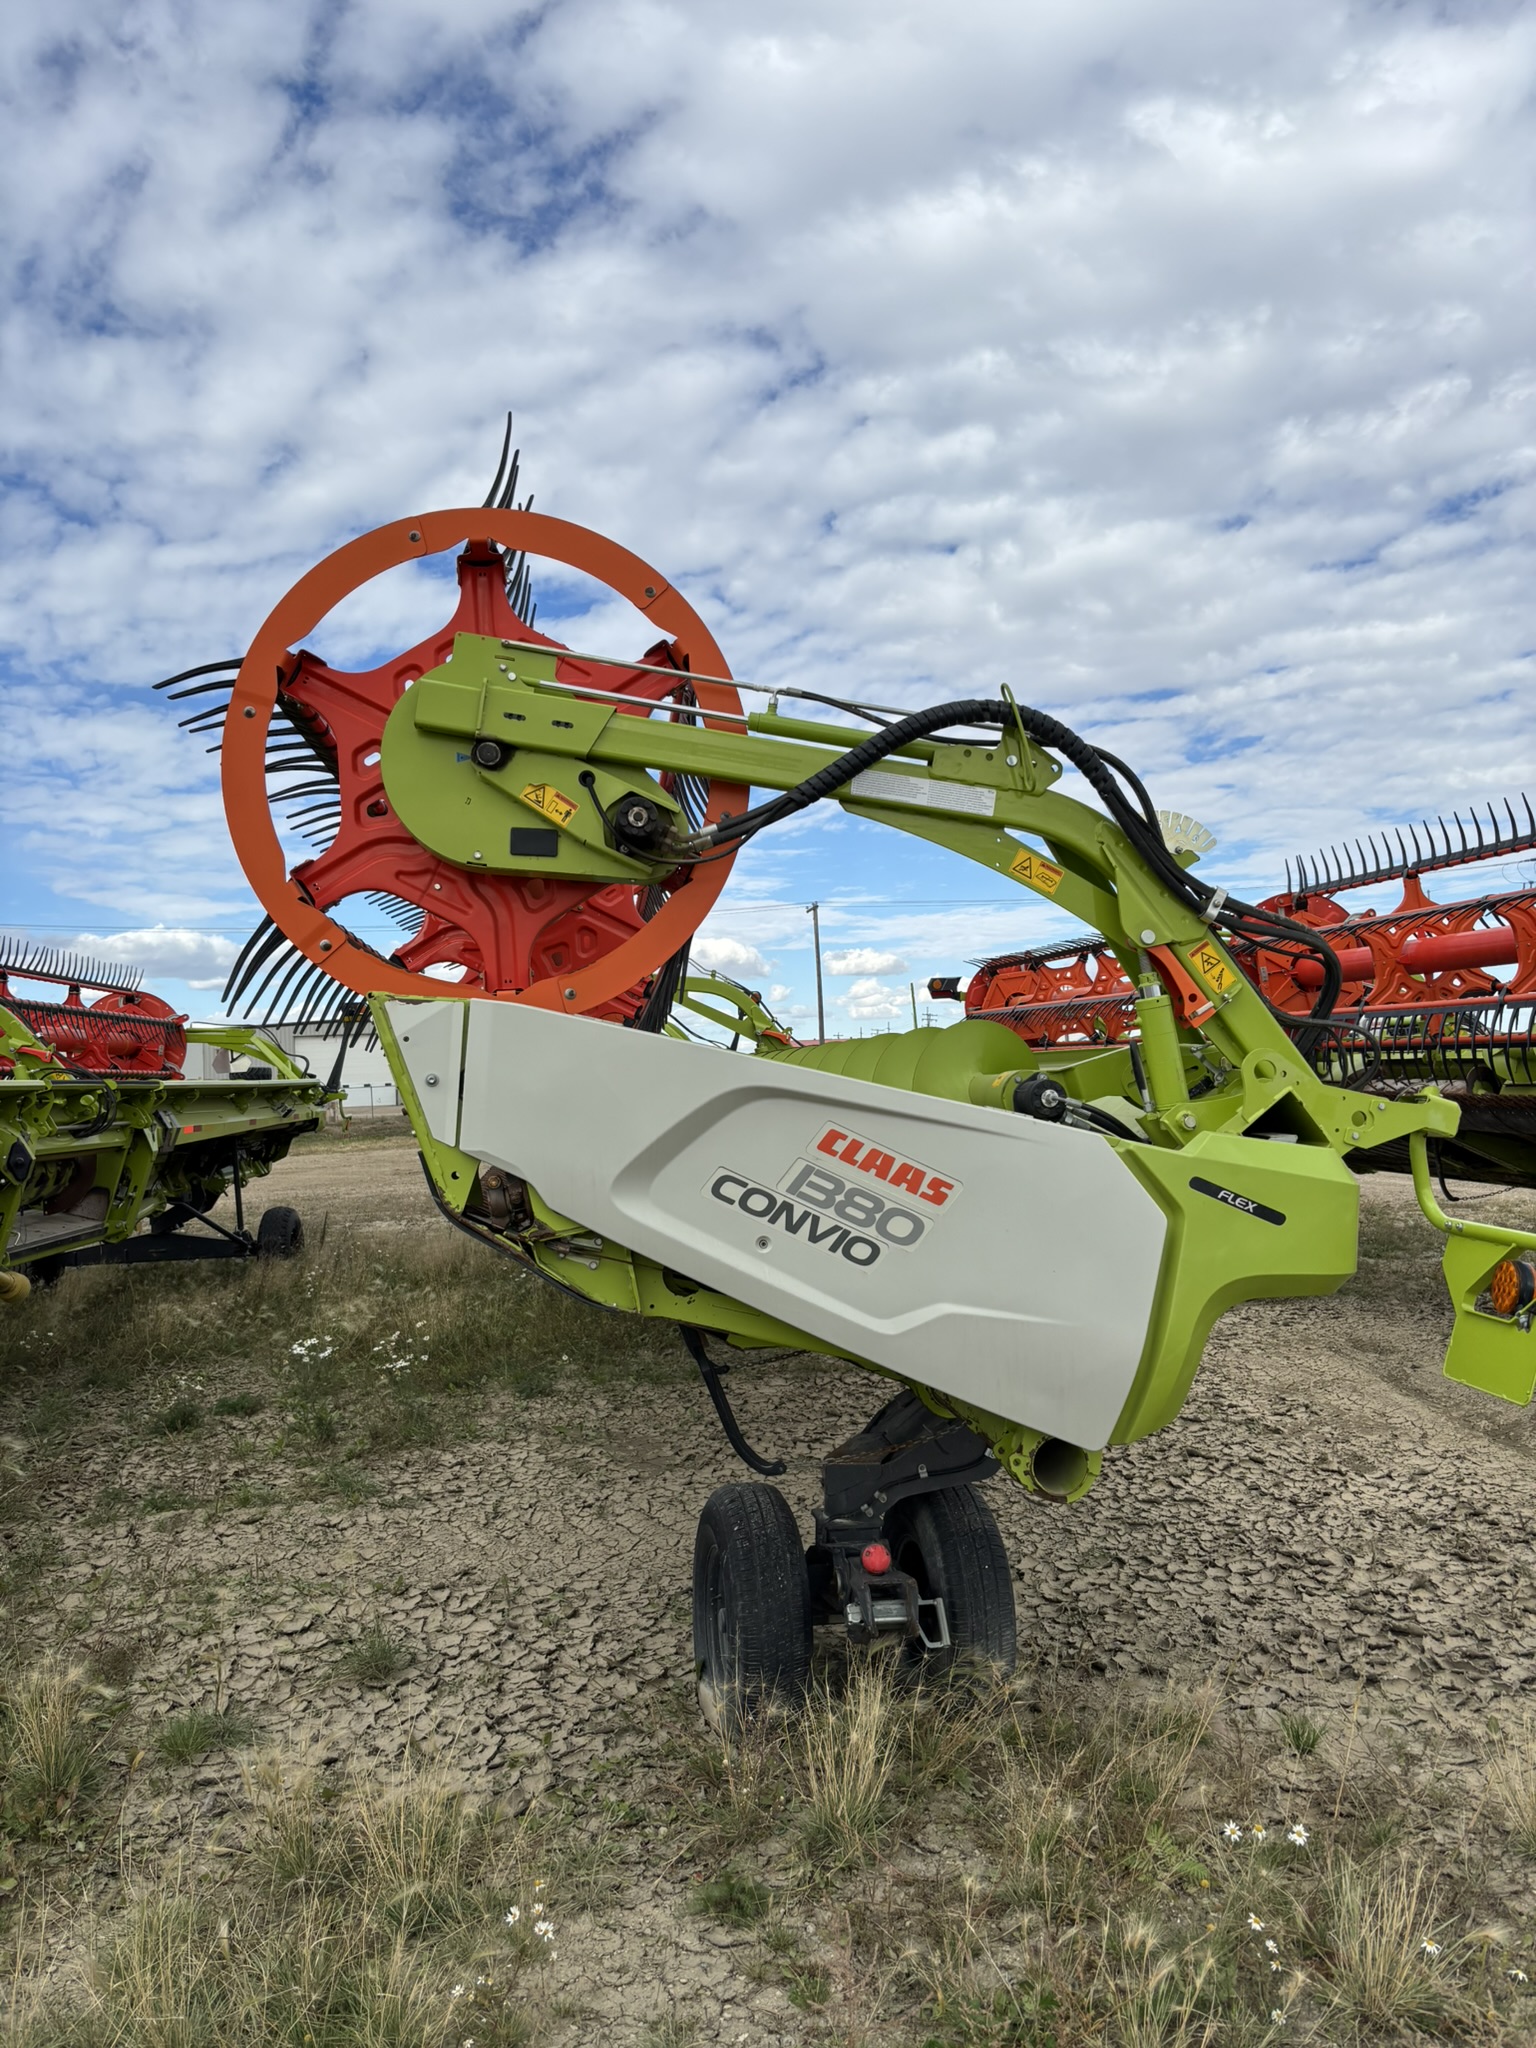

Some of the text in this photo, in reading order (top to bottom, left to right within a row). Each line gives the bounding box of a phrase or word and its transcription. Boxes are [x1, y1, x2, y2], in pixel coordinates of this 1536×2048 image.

[785, 1163, 925, 1246] 1380
[816, 1128, 955, 1206] CLAAS
[1217, 1190, 1258, 1213] FLEX
[711, 1174, 881, 1266] CONVIO
